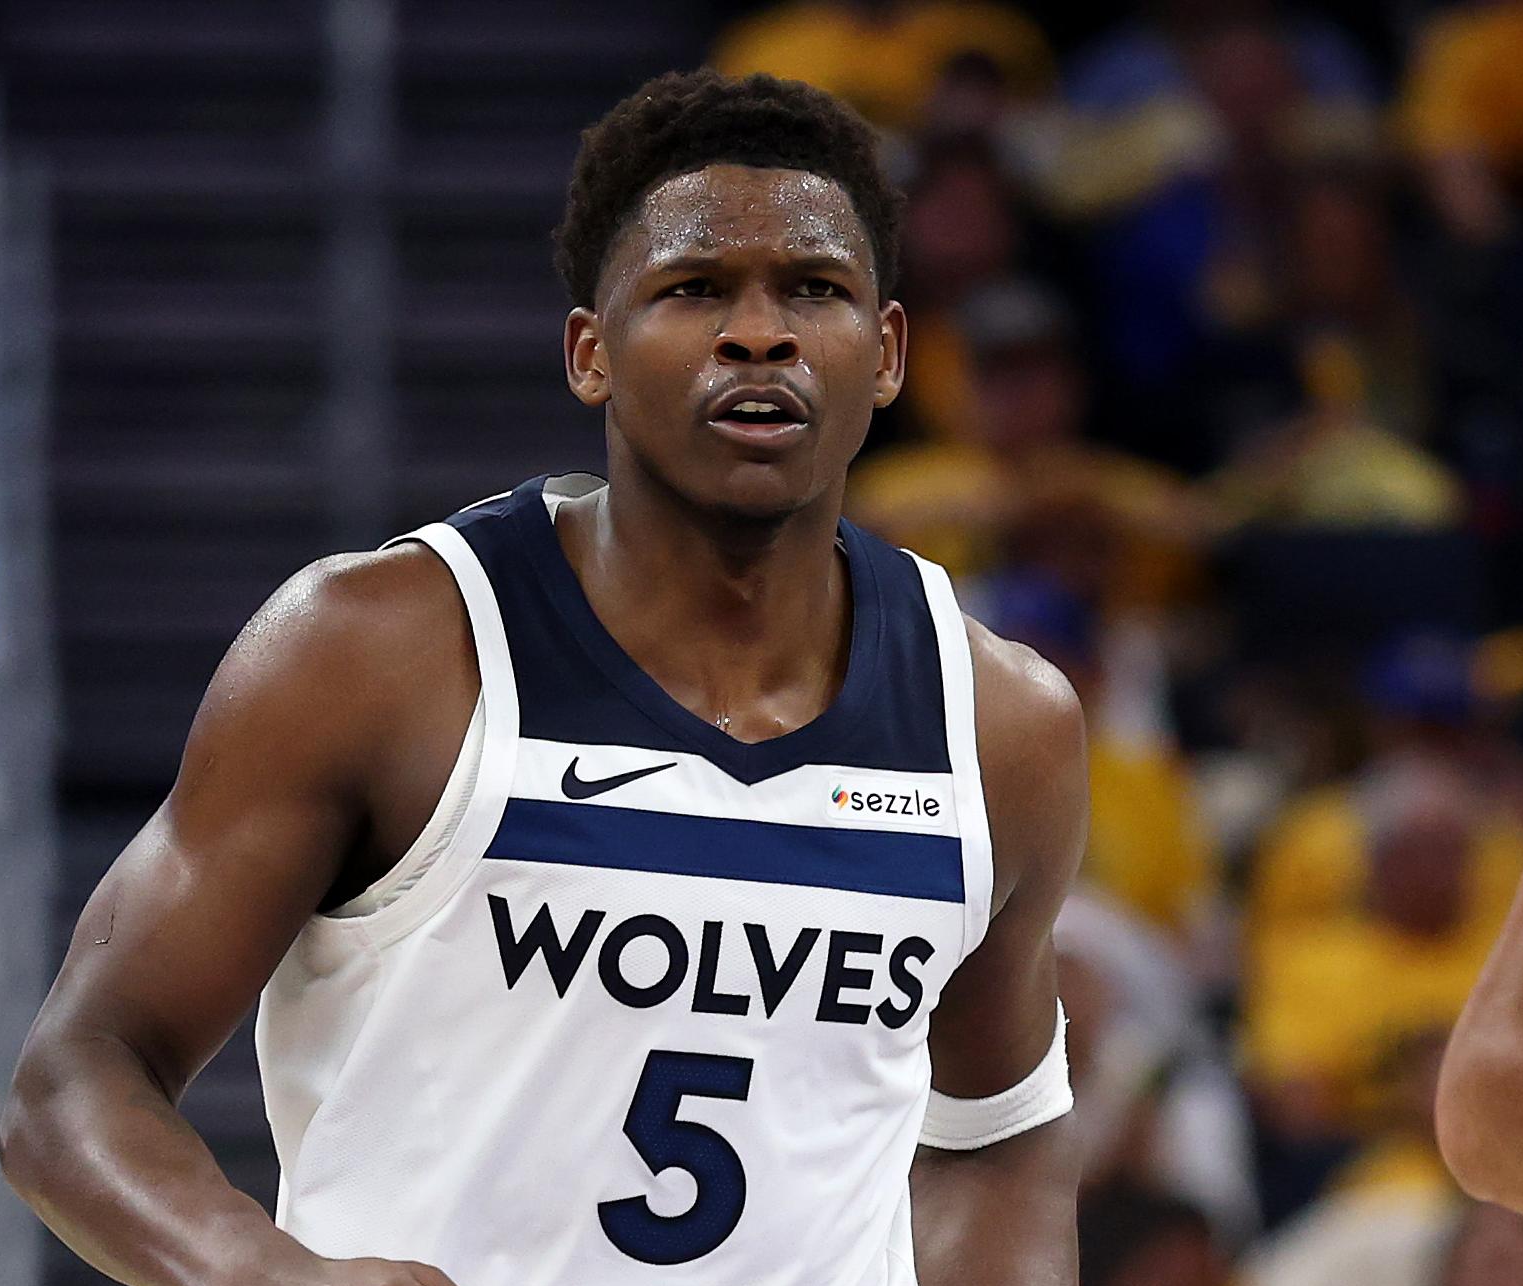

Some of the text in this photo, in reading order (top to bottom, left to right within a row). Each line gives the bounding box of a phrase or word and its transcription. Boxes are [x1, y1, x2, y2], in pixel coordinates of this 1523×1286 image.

[849, 788, 941, 818] sezzle
[485, 891, 937, 1031] WOLVES
[595, 1047, 756, 1267] 5
